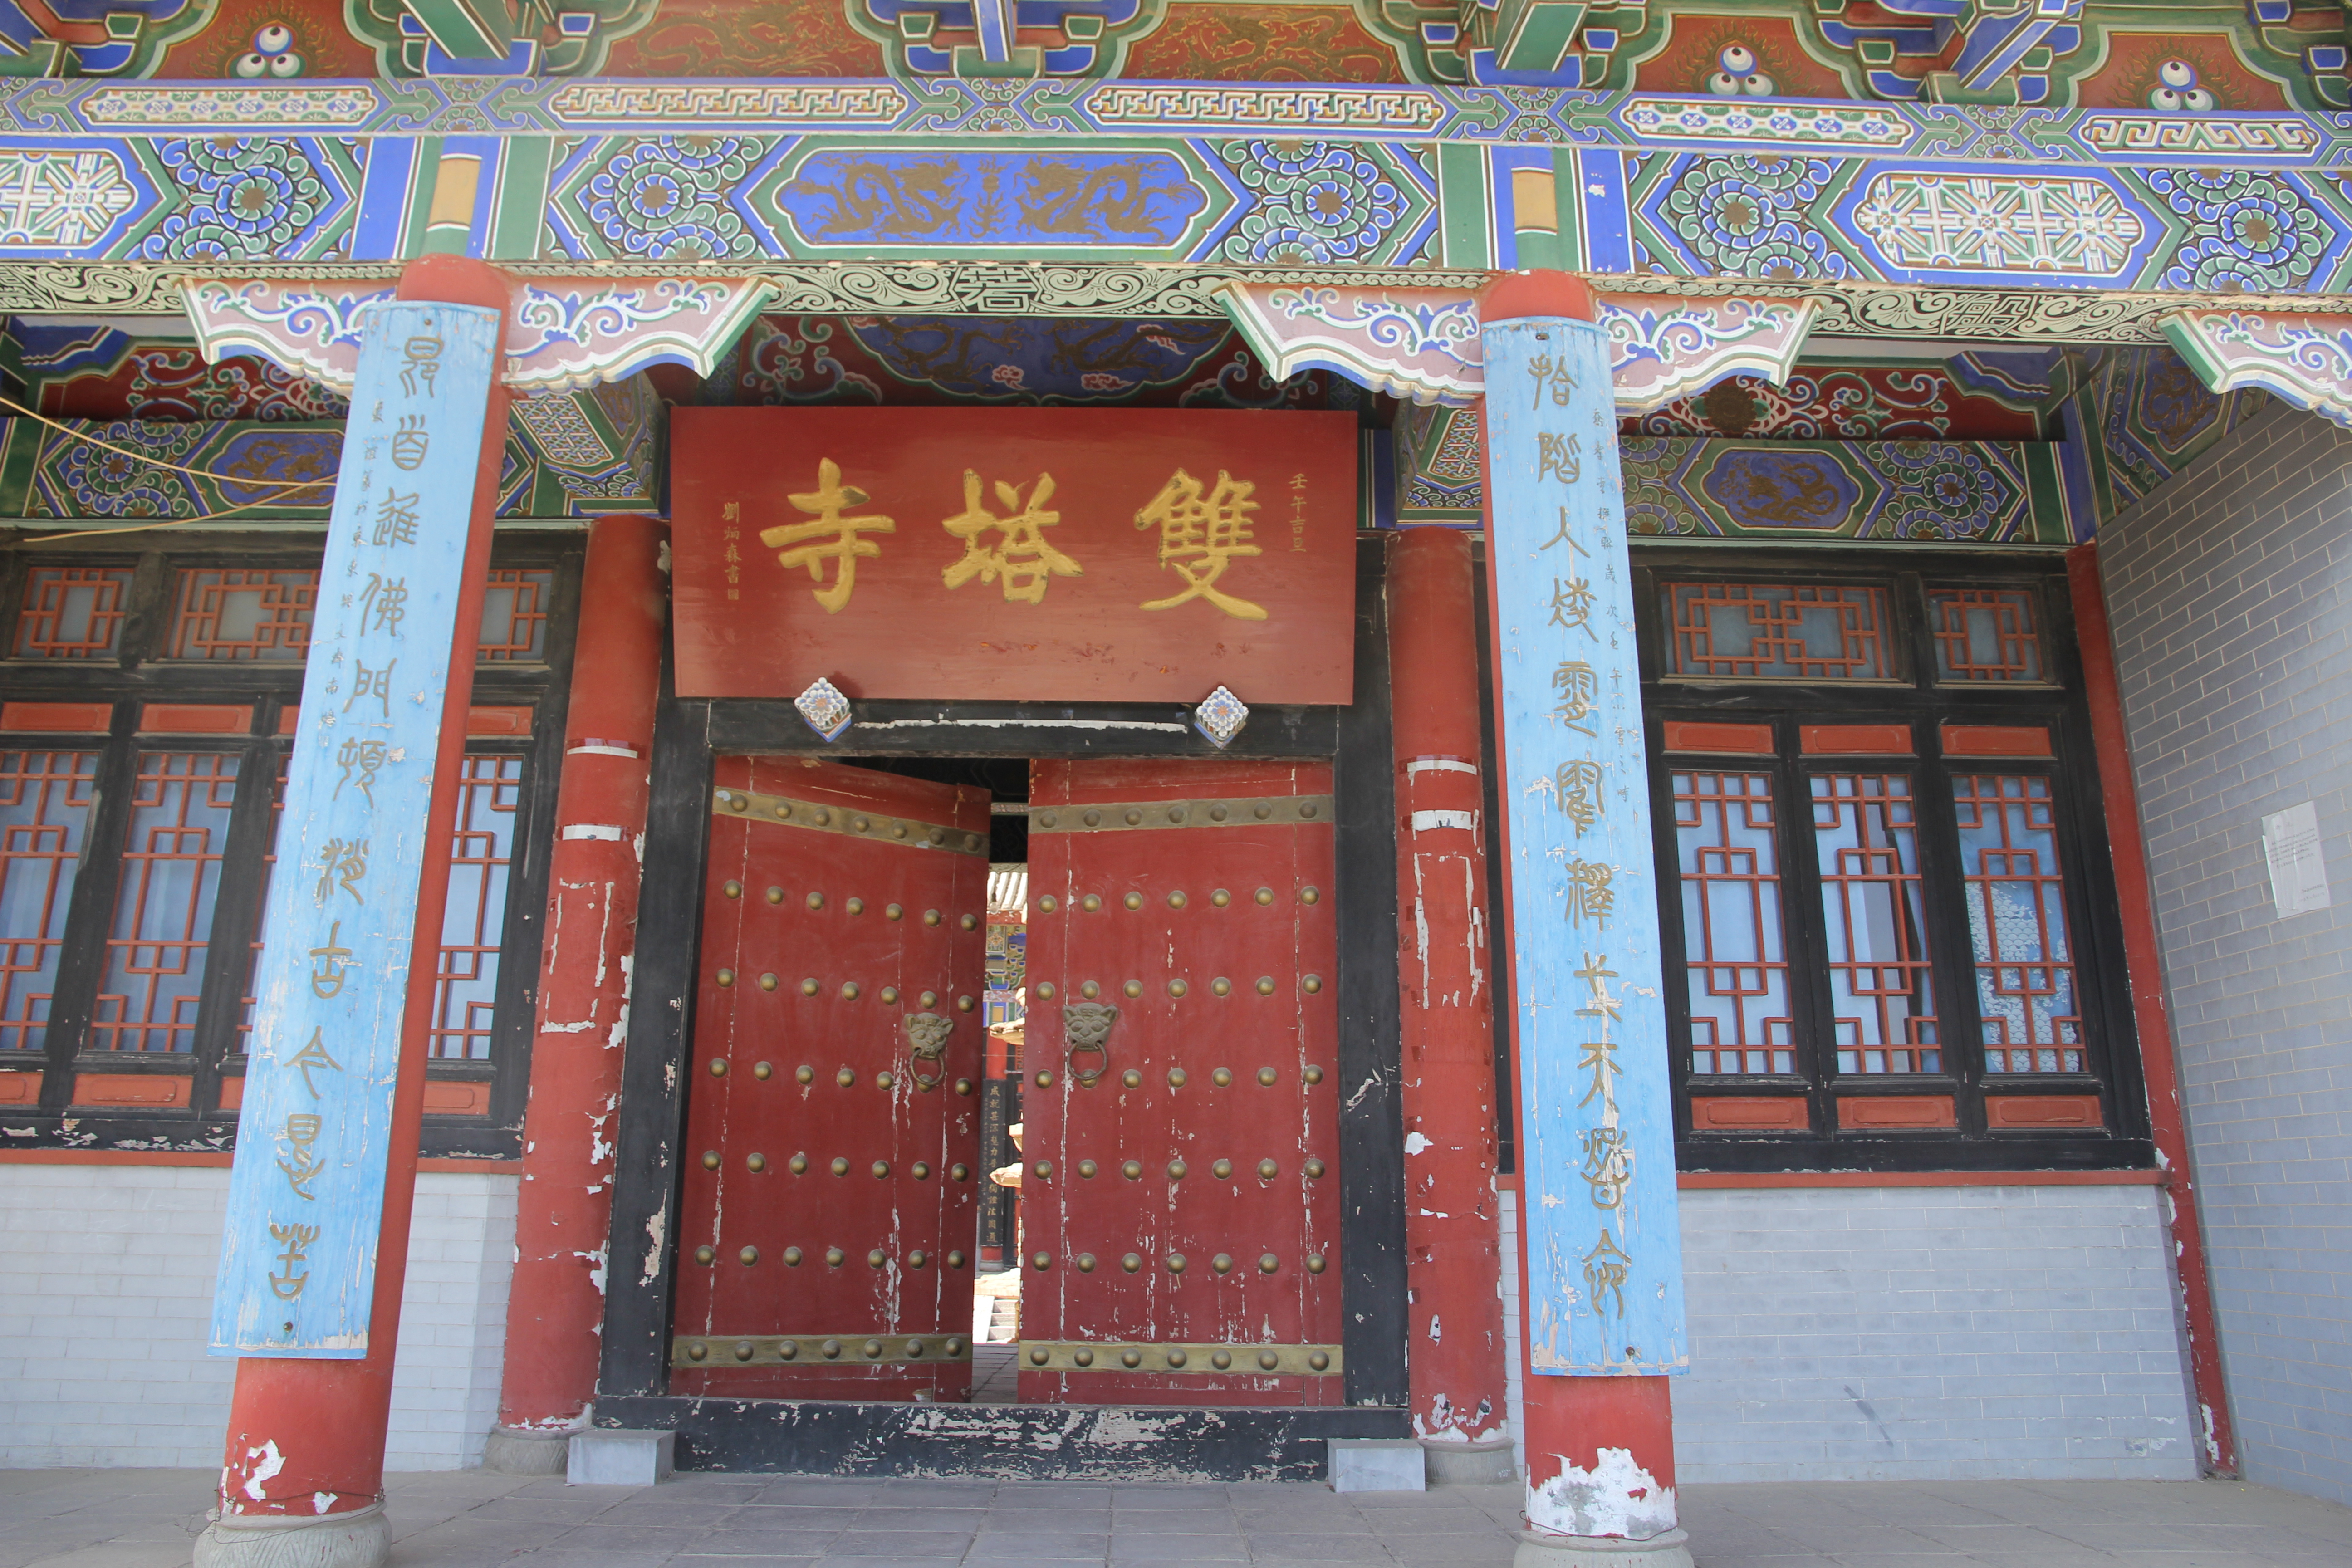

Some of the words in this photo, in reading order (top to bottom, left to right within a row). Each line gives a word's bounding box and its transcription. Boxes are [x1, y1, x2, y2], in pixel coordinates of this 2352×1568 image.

[722, 501, 742, 584] 劉炳森書
[1288, 473, 1308, 552] 壬午吉旦
